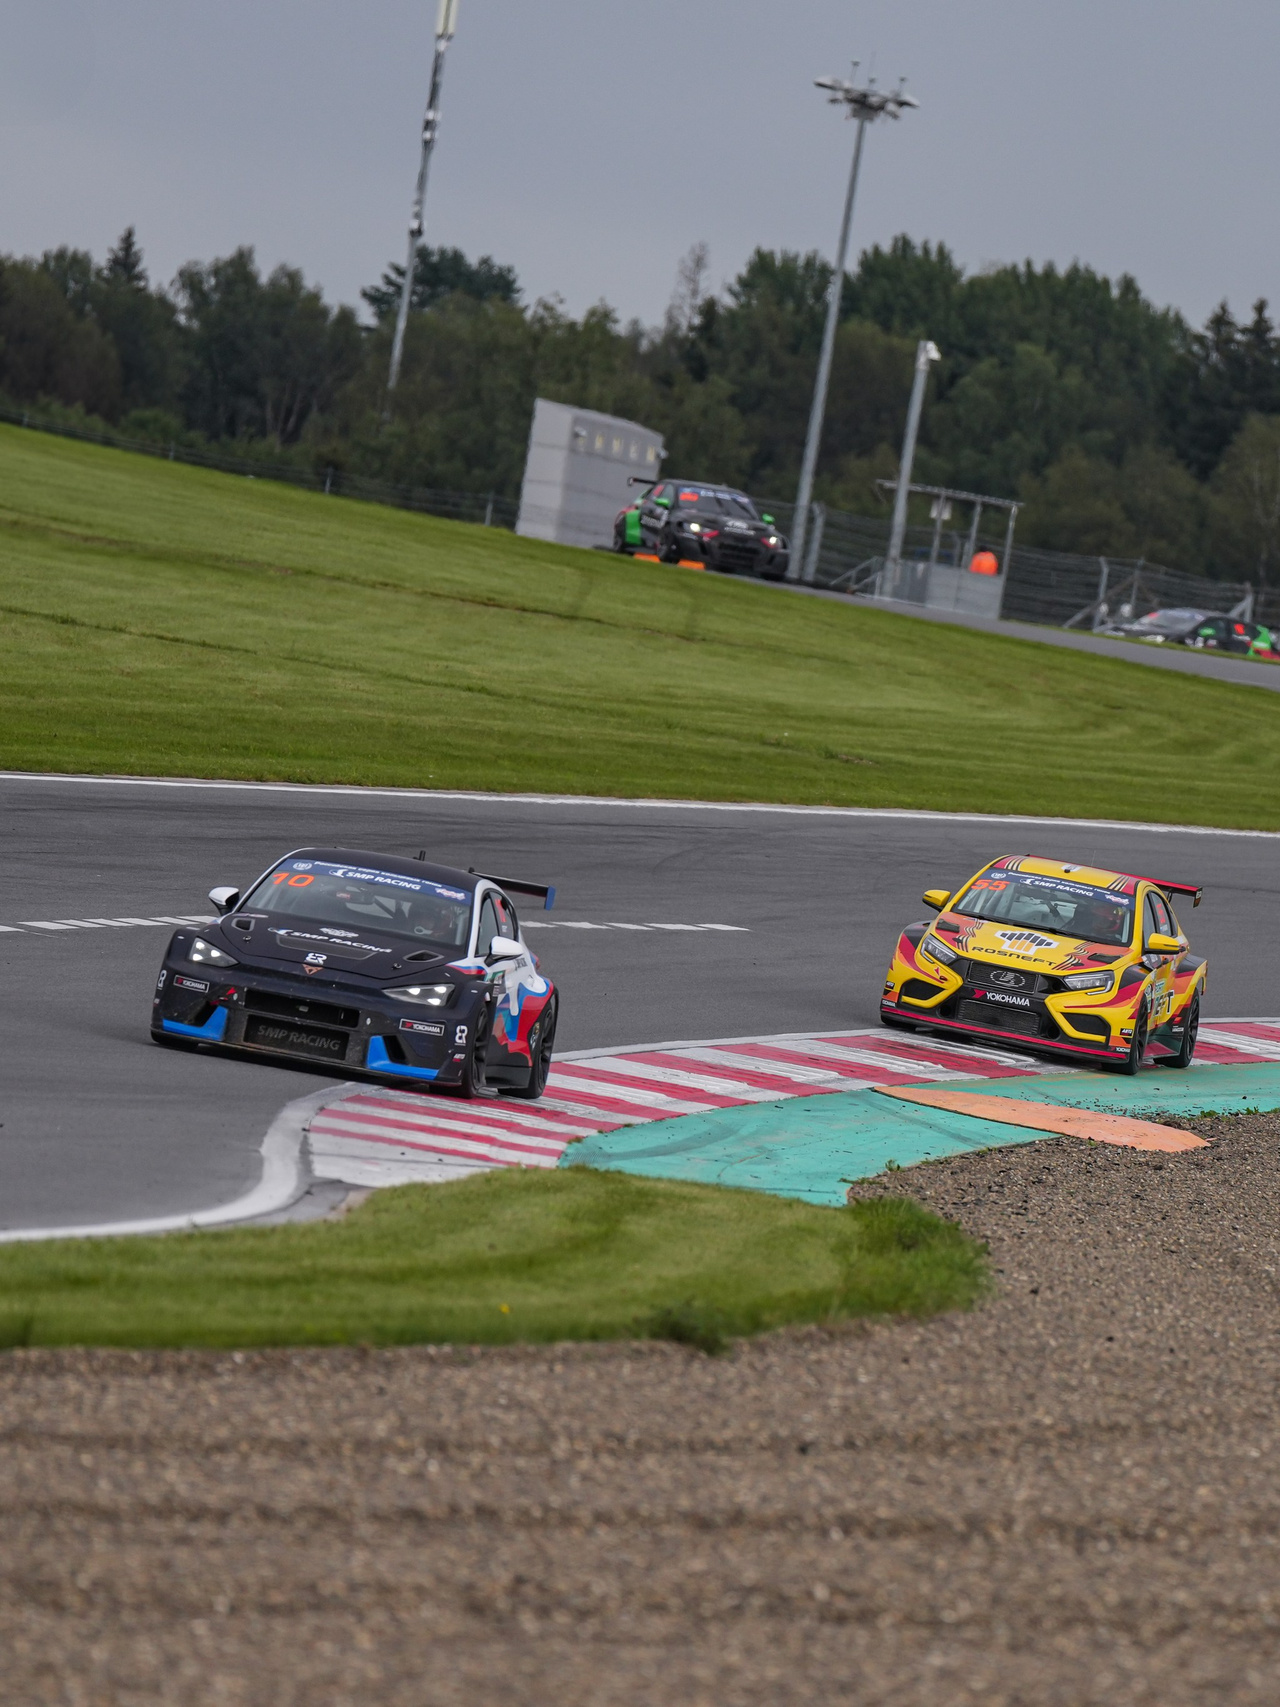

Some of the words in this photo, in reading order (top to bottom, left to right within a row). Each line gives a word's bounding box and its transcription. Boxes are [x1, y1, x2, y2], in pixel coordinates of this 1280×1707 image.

[272, 872, 315, 887] 10
[346, 871, 374, 880] SMP
[374, 876, 421, 890] RACING
[970, 879, 1009, 891] 55
[1033, 880, 1057, 888] SMP
[1056, 884, 1095, 897] RACING
[290, 931, 329, 940] SMP
[329, 938, 393, 953] RACING
[972, 946, 1058, 967] ROSNEFT
[986, 992, 1031, 1007] YOKOHAMA
[413, 1023, 441, 1033] YOKOHAMA
[258, 1024, 287, 1038] SMP
[288, 1031, 342, 1051] RACING
